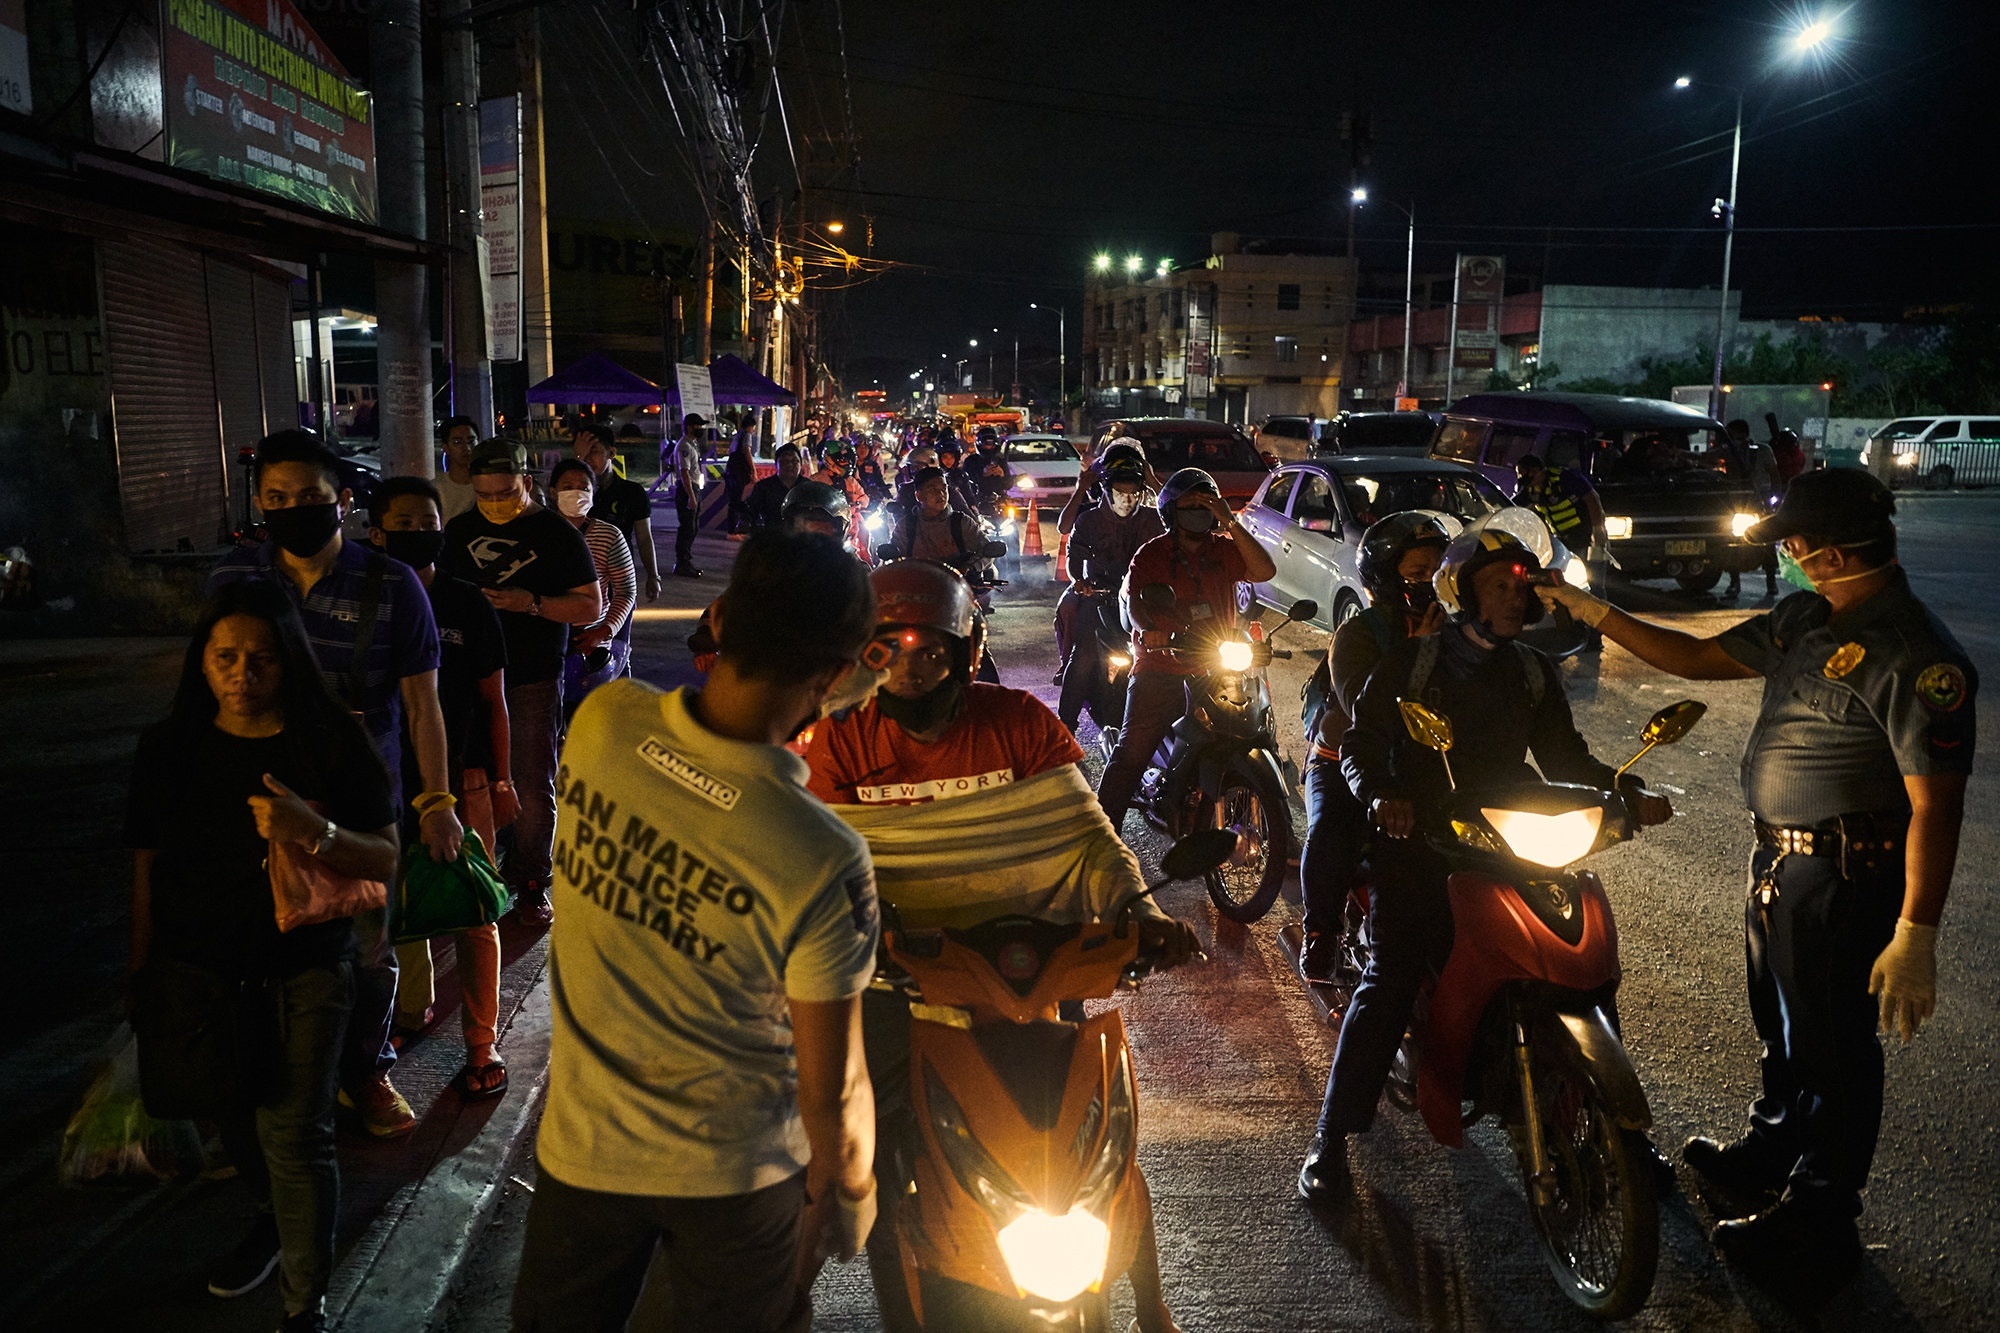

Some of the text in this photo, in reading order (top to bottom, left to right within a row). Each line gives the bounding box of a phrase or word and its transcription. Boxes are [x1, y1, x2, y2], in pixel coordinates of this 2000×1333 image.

[0, 77, 22, 103] 16
[214, 55, 267, 100] REPAIR
[271, 83, 297, 114] AND
[225, 15, 259, 68] AUTO
[259, 34, 318, 99] ELECTRICAL
[861, 771, 1010, 799] NEW YORK
[556, 764, 754, 915] SAN MATEO
[575, 820, 702, 922] POLICE
[555, 840, 727, 963] AUXILIARY
